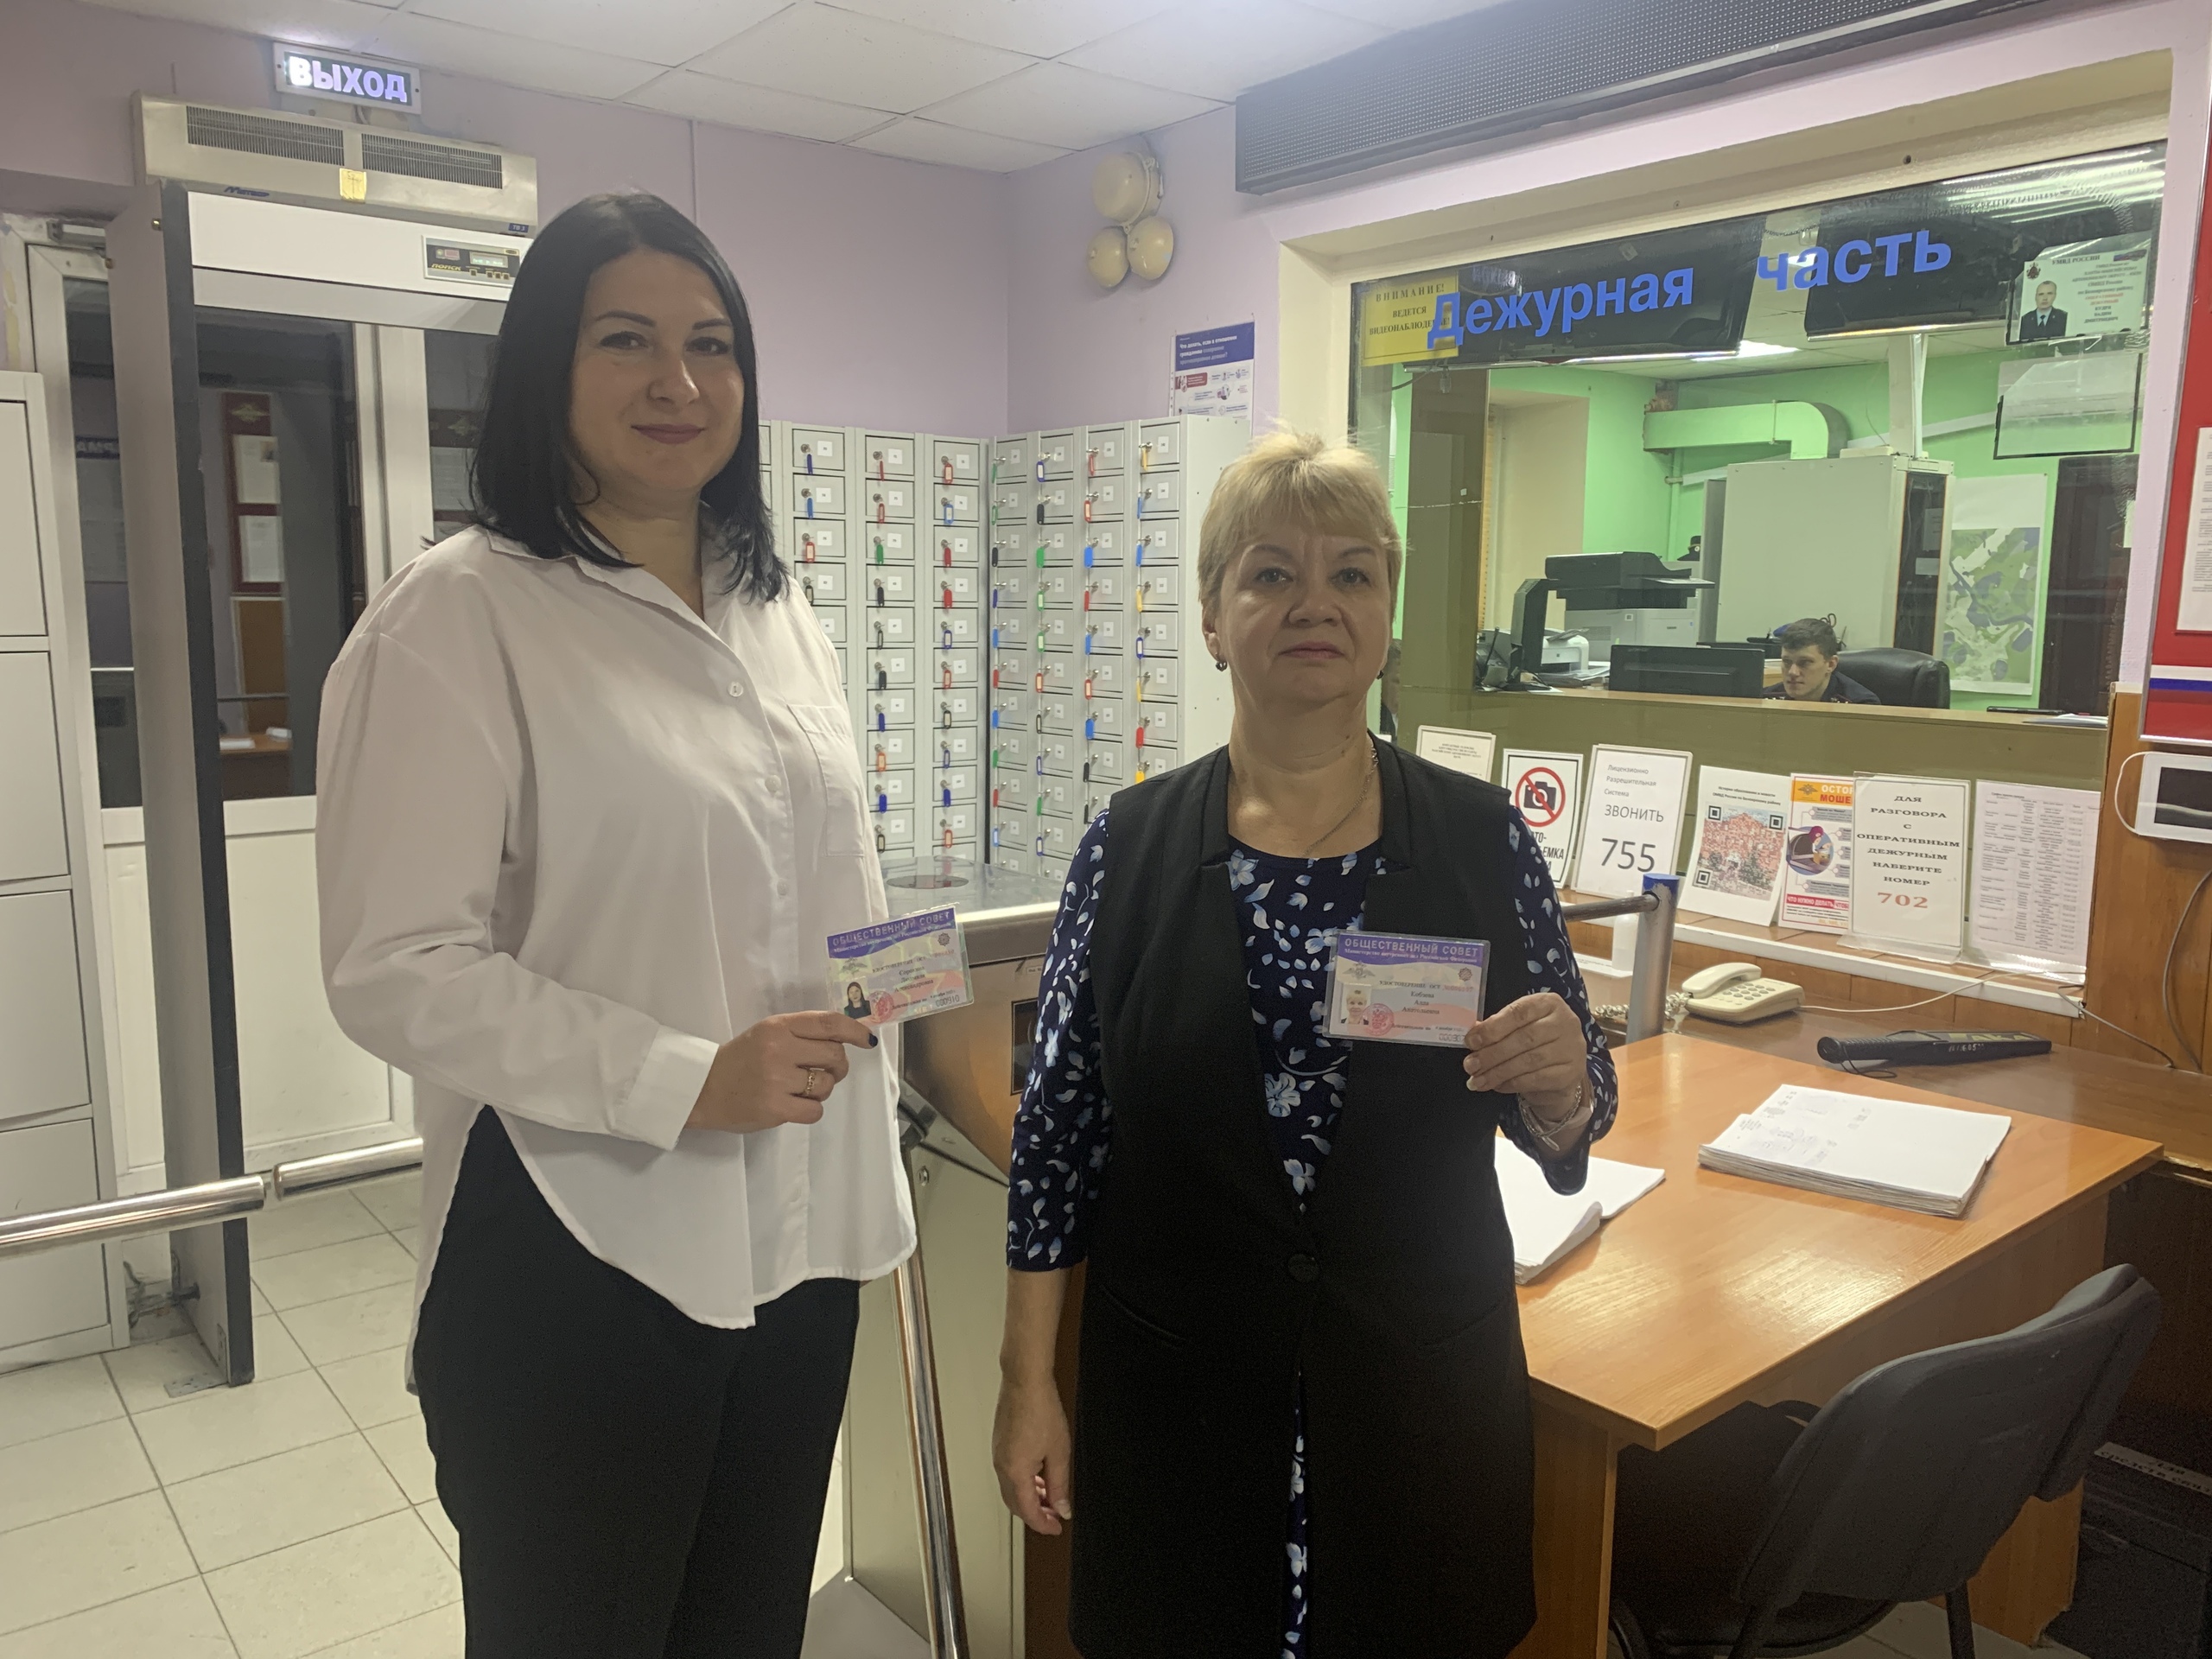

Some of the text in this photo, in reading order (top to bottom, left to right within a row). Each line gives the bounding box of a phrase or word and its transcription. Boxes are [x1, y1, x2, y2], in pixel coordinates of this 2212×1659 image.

[288, 56, 408, 103] ВЫХОД
[1376, 283, 1445, 302] ВНИМАНИЕ!
[1427, 229, 1952, 350] Дежурная часть
[1392, 306, 1427, 318] ВЕДЕТСЯ
[1370, 317, 1450, 335] ВИДЕОНАБЛЮДЕЕ!
[1607, 765, 1649, 775] Лицензионно
[1605, 775, 1656, 787] Разрешительная
[1604, 788, 1630, 798] Система
[1820, 794, 1853, 804] МОШЕ
[1604, 804, 1664, 823] ЗВОНИТЬ
[1871, 807, 1947, 818] РАЗГОВОРА
[1533, 831, 1547, 843] ТО-
[1857, 833, 1960, 848] ОПЕРАТИВНЫМ
[1540, 846, 1564, 860] ЕМКА
[1601, 837, 1656, 873] 755
[1867, 848, 1948, 861] ДЕЖУРНЫМ
[1872, 861, 1942, 874] НАБЕРИТЕ
[1884, 876, 1930, 887] НОМЕР
[1797, 897, 1815, 906] НУЖНО
[1877, 892, 1929, 909] 702
[832, 911, 950, 946] ОБЩЕСТВЕННЫЙ СОВЕТ
[1344, 938, 1478, 957] ОБЩЕСТВЕННЫЙ СОВЕТ
[1344, 948, 1381, 957] Министерство
[1379, 980, 1427, 988] УДОСТОВЕРЕНИЕ
[935, 995, 960, 1007] 000910
